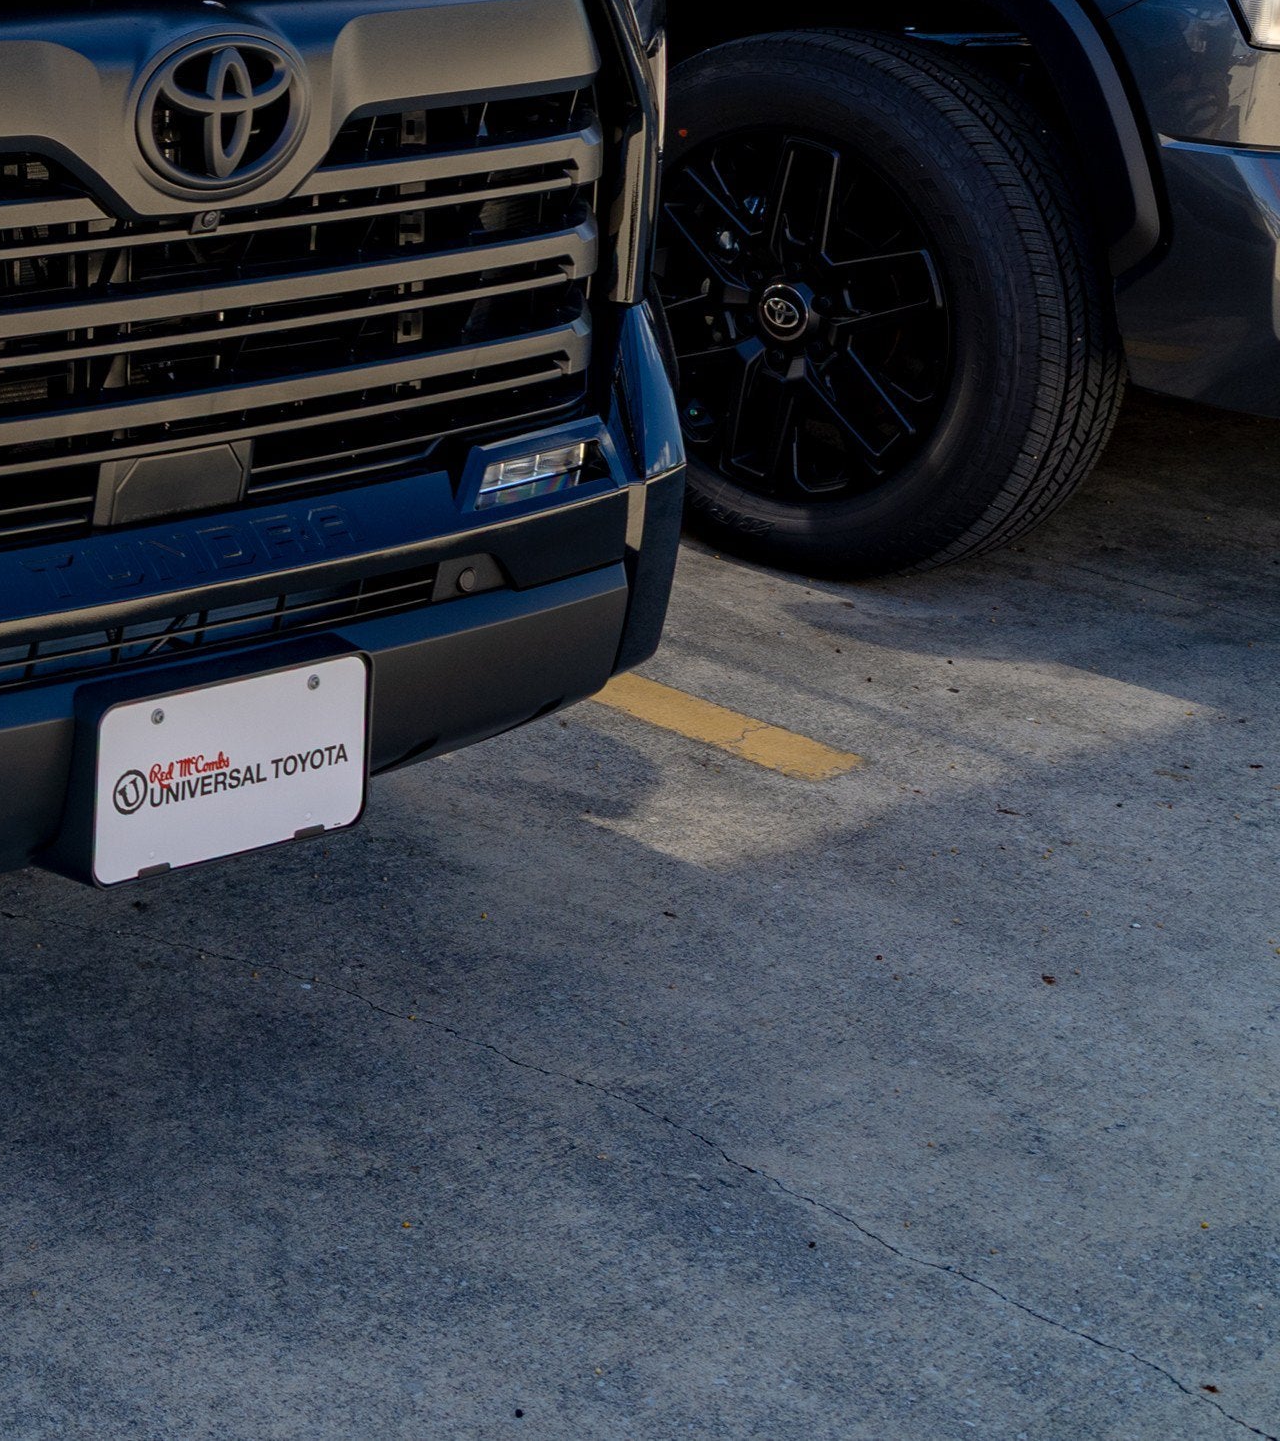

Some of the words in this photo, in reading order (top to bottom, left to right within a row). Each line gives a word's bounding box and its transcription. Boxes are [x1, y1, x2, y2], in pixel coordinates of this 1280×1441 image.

[18, 504, 364, 599] TUNDRA
[149, 761, 174, 790] Red
[177, 751, 230, 777] McCombs
[150, 763, 268, 807] UNIVERSAL
[271, 743, 348, 779] TOYOTA
